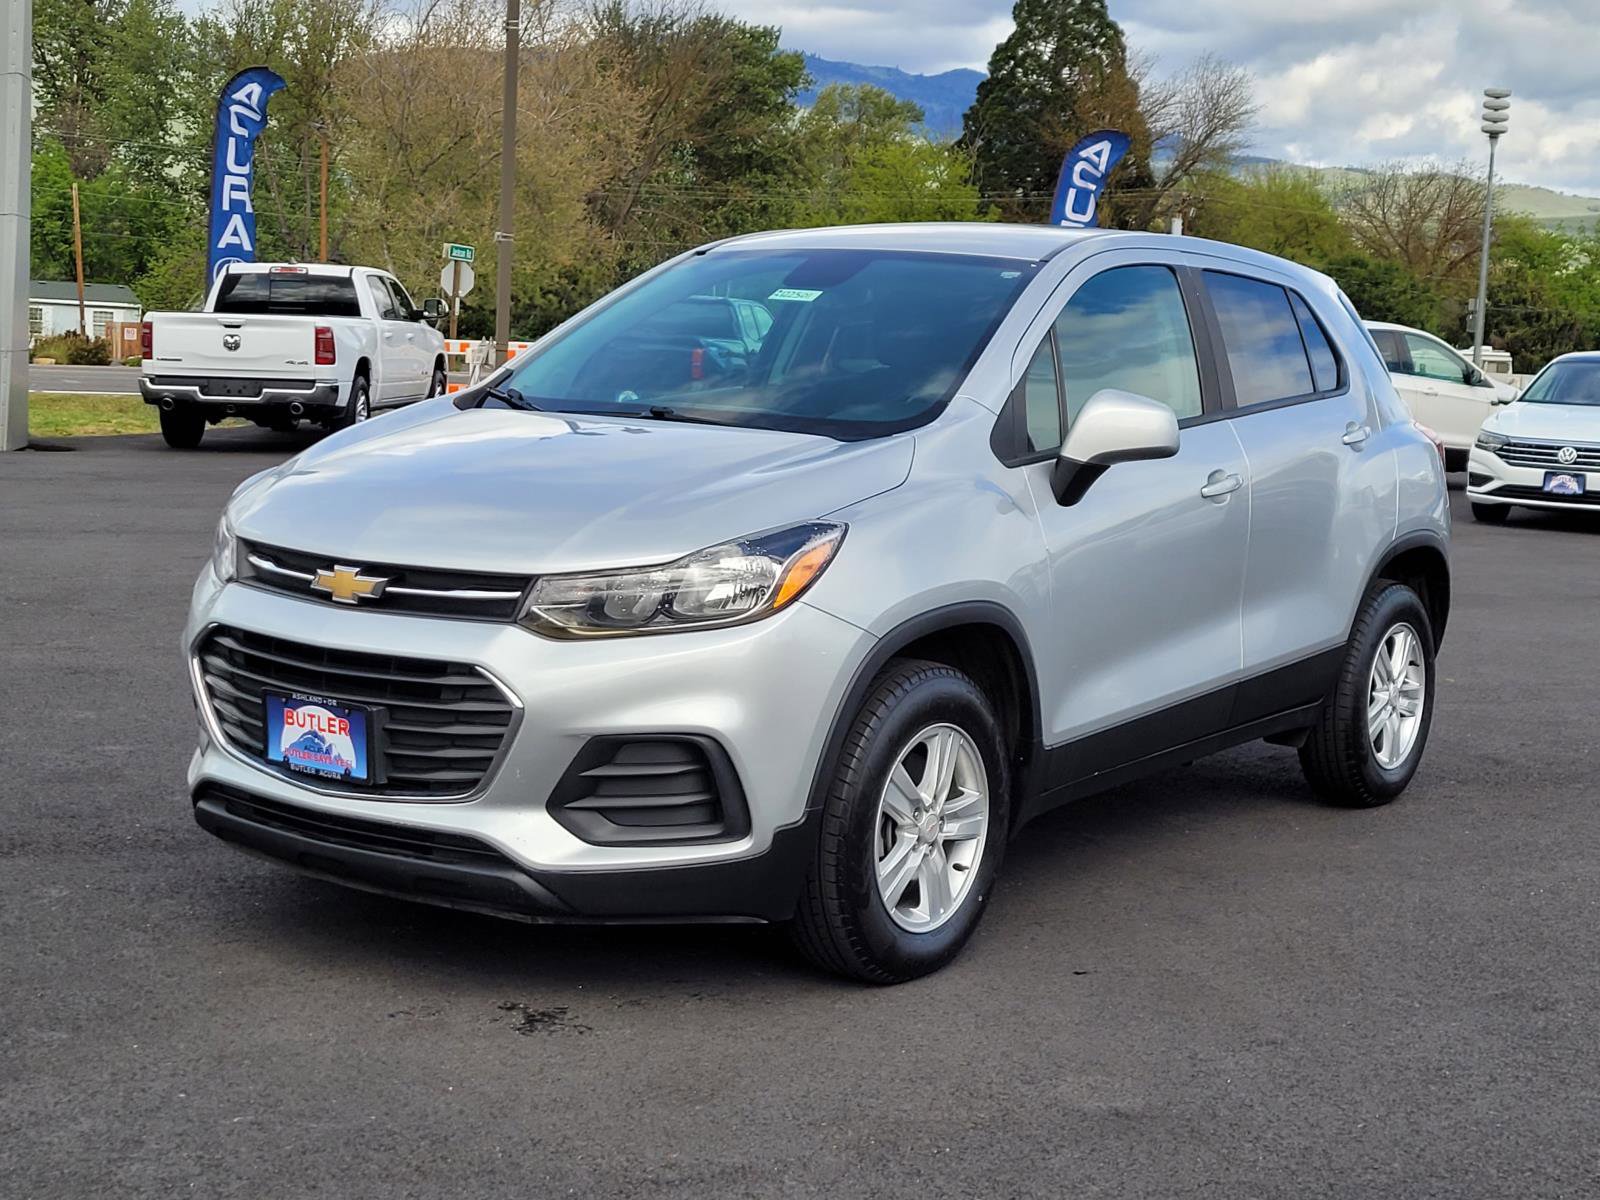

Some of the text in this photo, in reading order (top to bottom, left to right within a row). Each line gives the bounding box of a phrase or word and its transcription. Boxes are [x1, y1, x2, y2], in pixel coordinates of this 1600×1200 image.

[217, 82, 263, 251] ACURA
[1061, 140, 1112, 228] ACU
[292, 693, 323, 704] ASHLAND
[284, 708, 350, 736] BUTLER
[304, 744, 331, 754] ACURA
[290, 763, 342, 780] BUTLER ACURA
